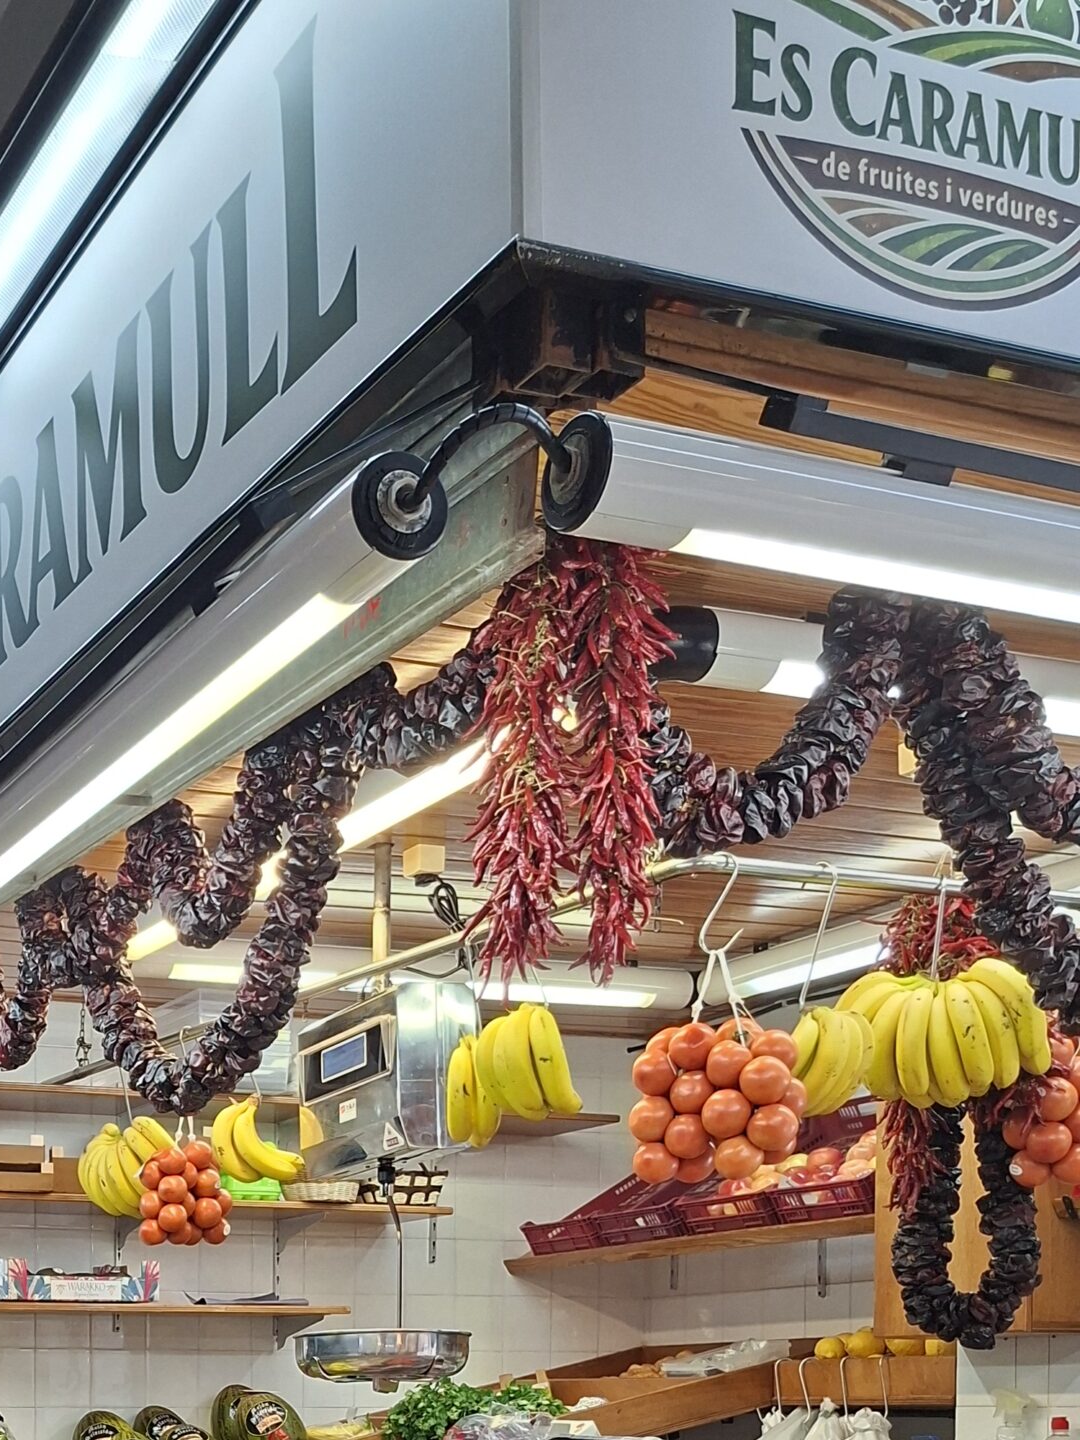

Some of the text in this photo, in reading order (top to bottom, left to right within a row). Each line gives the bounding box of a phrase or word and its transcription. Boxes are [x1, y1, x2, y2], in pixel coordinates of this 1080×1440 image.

[821, 151, 1058, 229] de fruites i verdures
